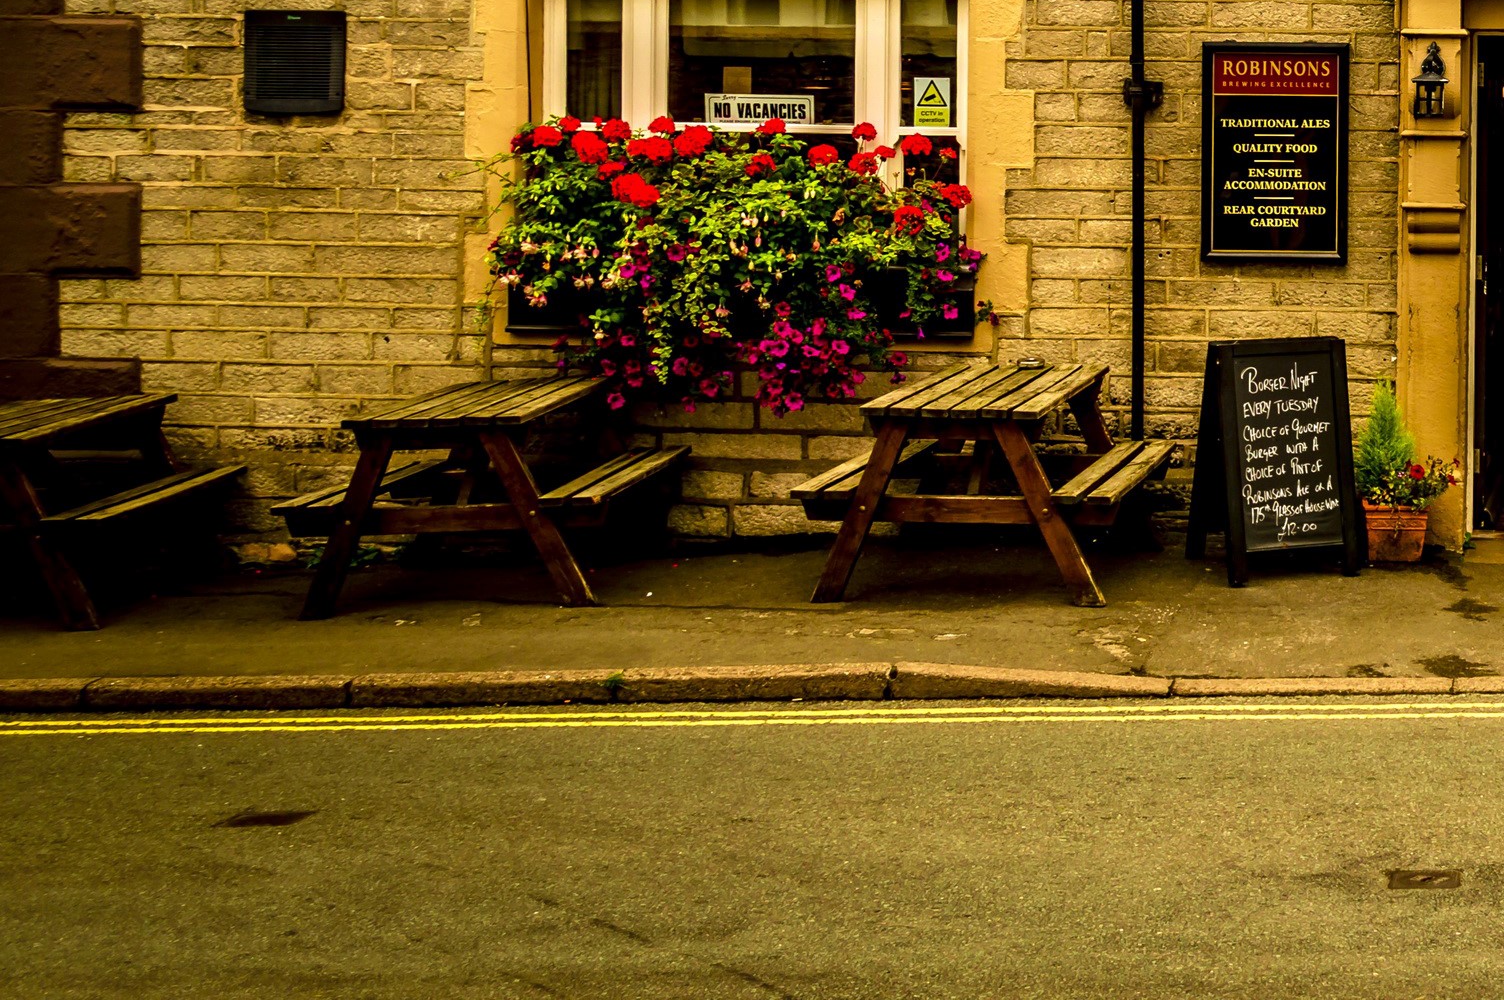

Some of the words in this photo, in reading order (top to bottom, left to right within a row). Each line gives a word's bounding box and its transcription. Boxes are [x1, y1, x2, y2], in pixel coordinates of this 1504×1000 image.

[1222, 60, 1331, 77] ROBINSONS
[1270, 81, 1330, 89] EXCELLENCE
[713, 102, 731, 119] NO
[737, 103, 806, 120] VACANCIES
[1220, 119, 1299, 128] TRADITIONAL
[1301, 119, 1331, 129] ALES
[1232, 143, 1283, 153] QUALITY
[1285, 144, 1318, 153] FOOD
[1248, 168, 1302, 178] EN-SUITE
[1223, 181, 1327, 191] ACCOMMODATION
[1223, 206, 1256, 215] REAR
[1257, 206, 1327, 216] COURTYARD
[1250, 218, 1299, 228] GARDEN
[1290, 362, 1318, 392] NIGHT
[1243, 400, 1272, 419] EVERY
[1274, 396, 1319, 415] TUESDAY
[1243, 425, 1278, 442] CHOICE
[1279, 425, 1290, 435] OF
[1291, 418, 1331, 440] GOURMET
[1245, 444, 1278, 462] BURGER
[1286, 442, 1308, 454] WITH
[1312, 436, 1320, 452] A
[1245, 465, 1274, 482] CHOICE
[1290, 457, 1311, 475] PINT
[1310, 459, 1323, 473] OF
[1242, 484, 1293, 505] ROBINSONS
[1326, 474, 1333, 491] A
[1272, 500, 1296, 527] GLASS
[1304, 499, 1325, 513] HOUSE
